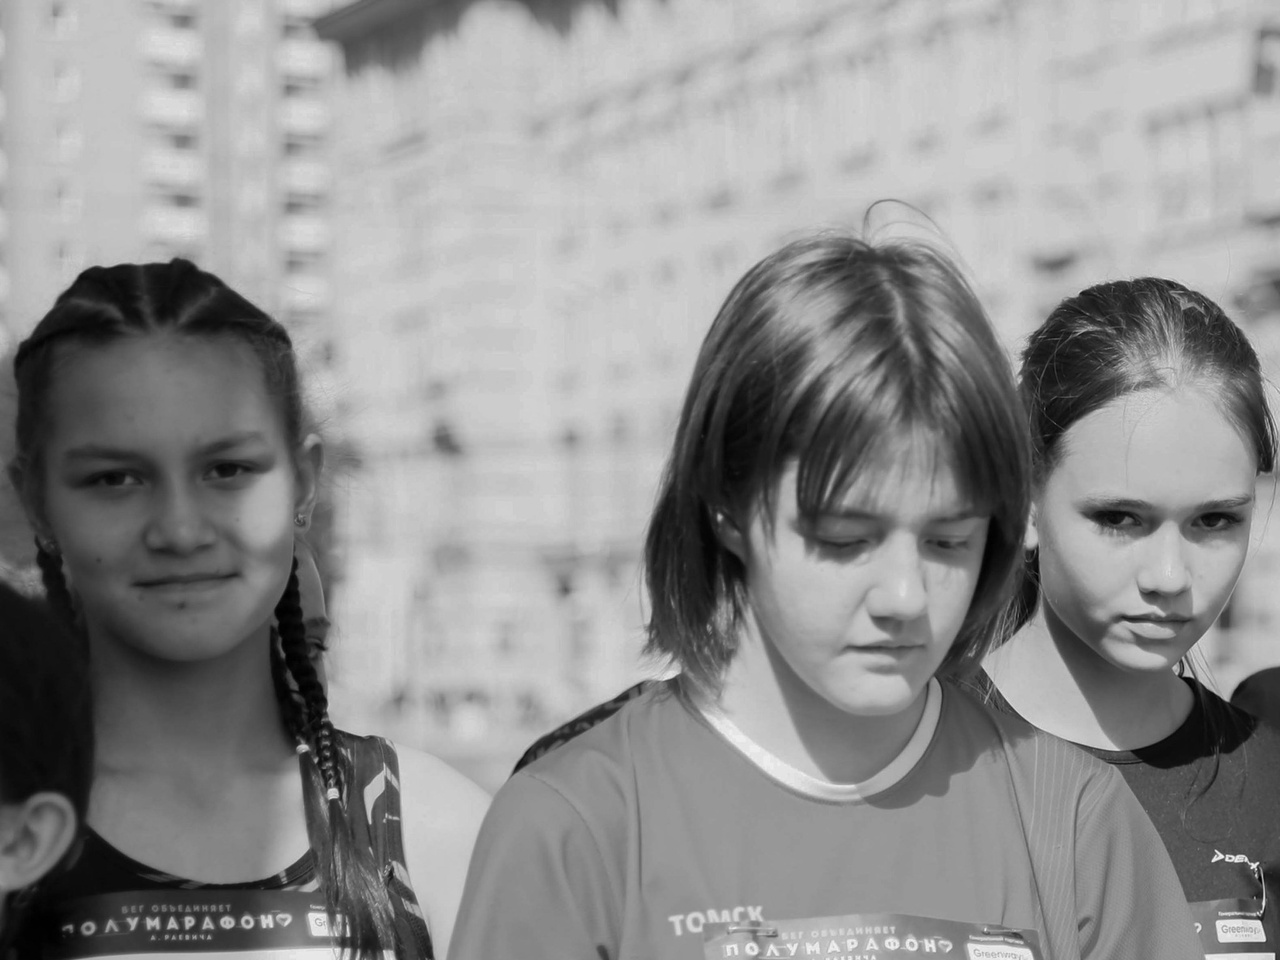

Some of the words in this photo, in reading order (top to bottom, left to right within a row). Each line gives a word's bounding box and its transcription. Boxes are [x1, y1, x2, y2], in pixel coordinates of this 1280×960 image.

[121, 905, 145, 915] БЕГ
[151, 903, 232, 914] ОБЪЕДИНЯЕТ
[781, 931, 804, 941] БЕГ
[810, 926, 897, 939] ОБЪЕДИНЯЕТ
[724, 936, 937, 957] ПОЛУМАРАФОН
